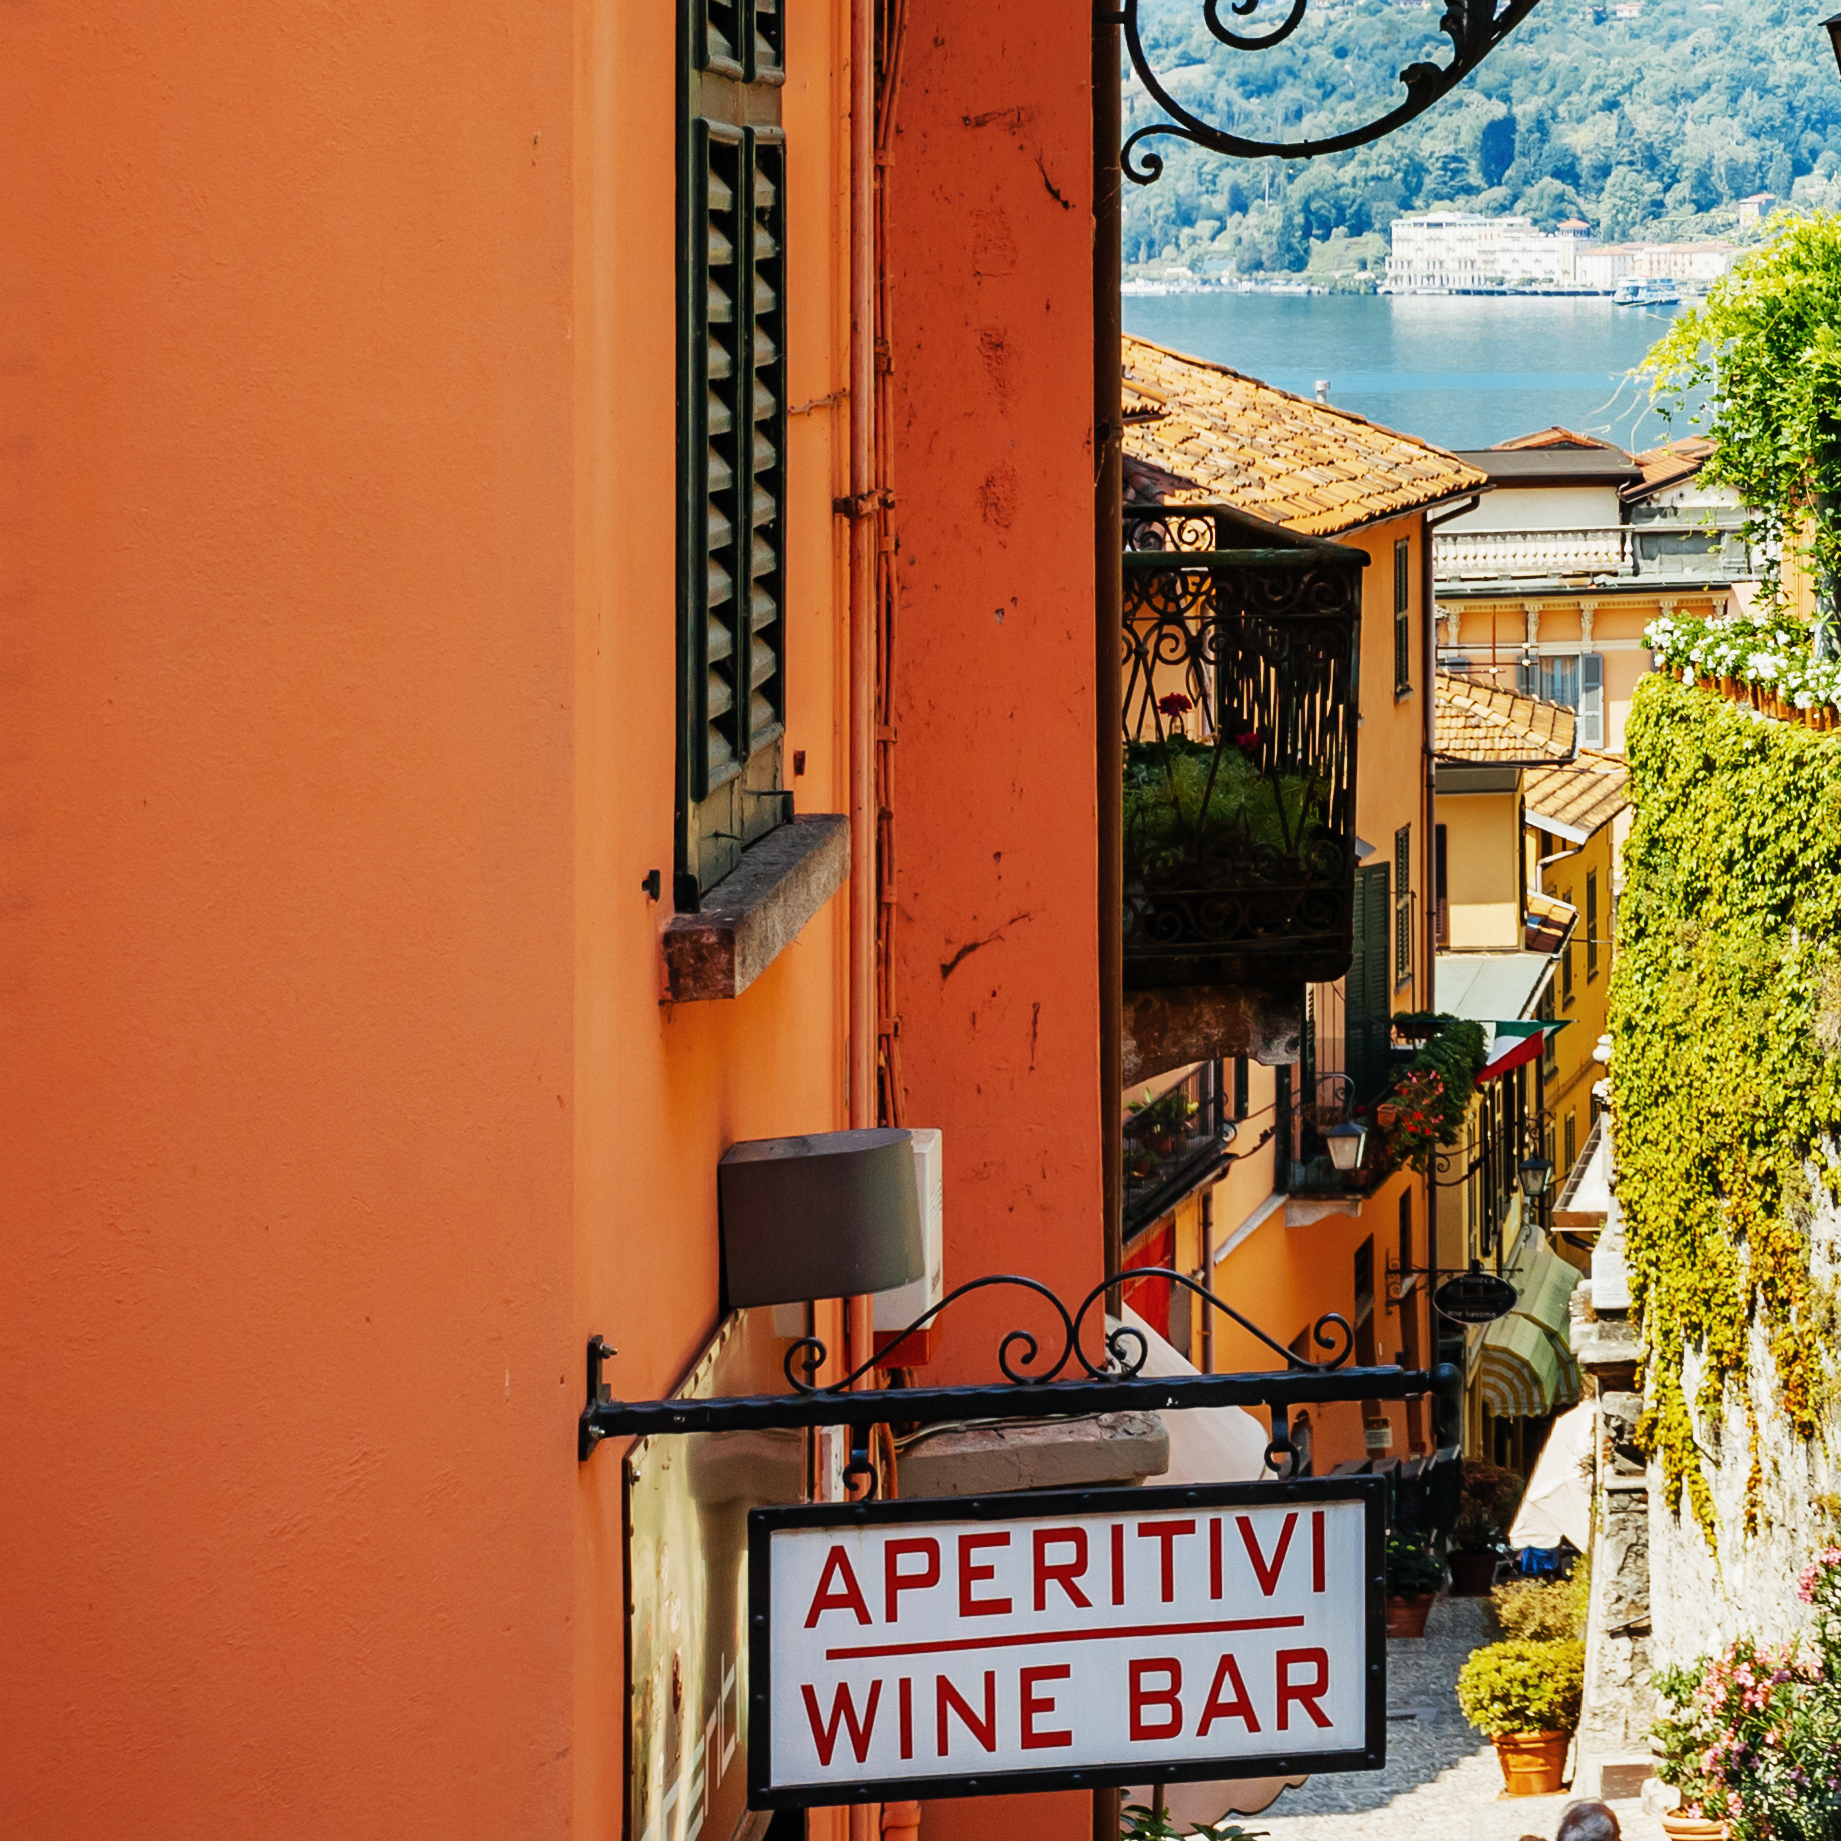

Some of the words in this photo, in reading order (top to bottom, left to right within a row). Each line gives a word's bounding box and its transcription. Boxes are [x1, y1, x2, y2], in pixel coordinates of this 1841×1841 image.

[804, 1510, 1326, 1628] APERITIVI
[801, 1663, 1072, 1765] WINE
[1128, 1647, 1331, 1741] BAR
